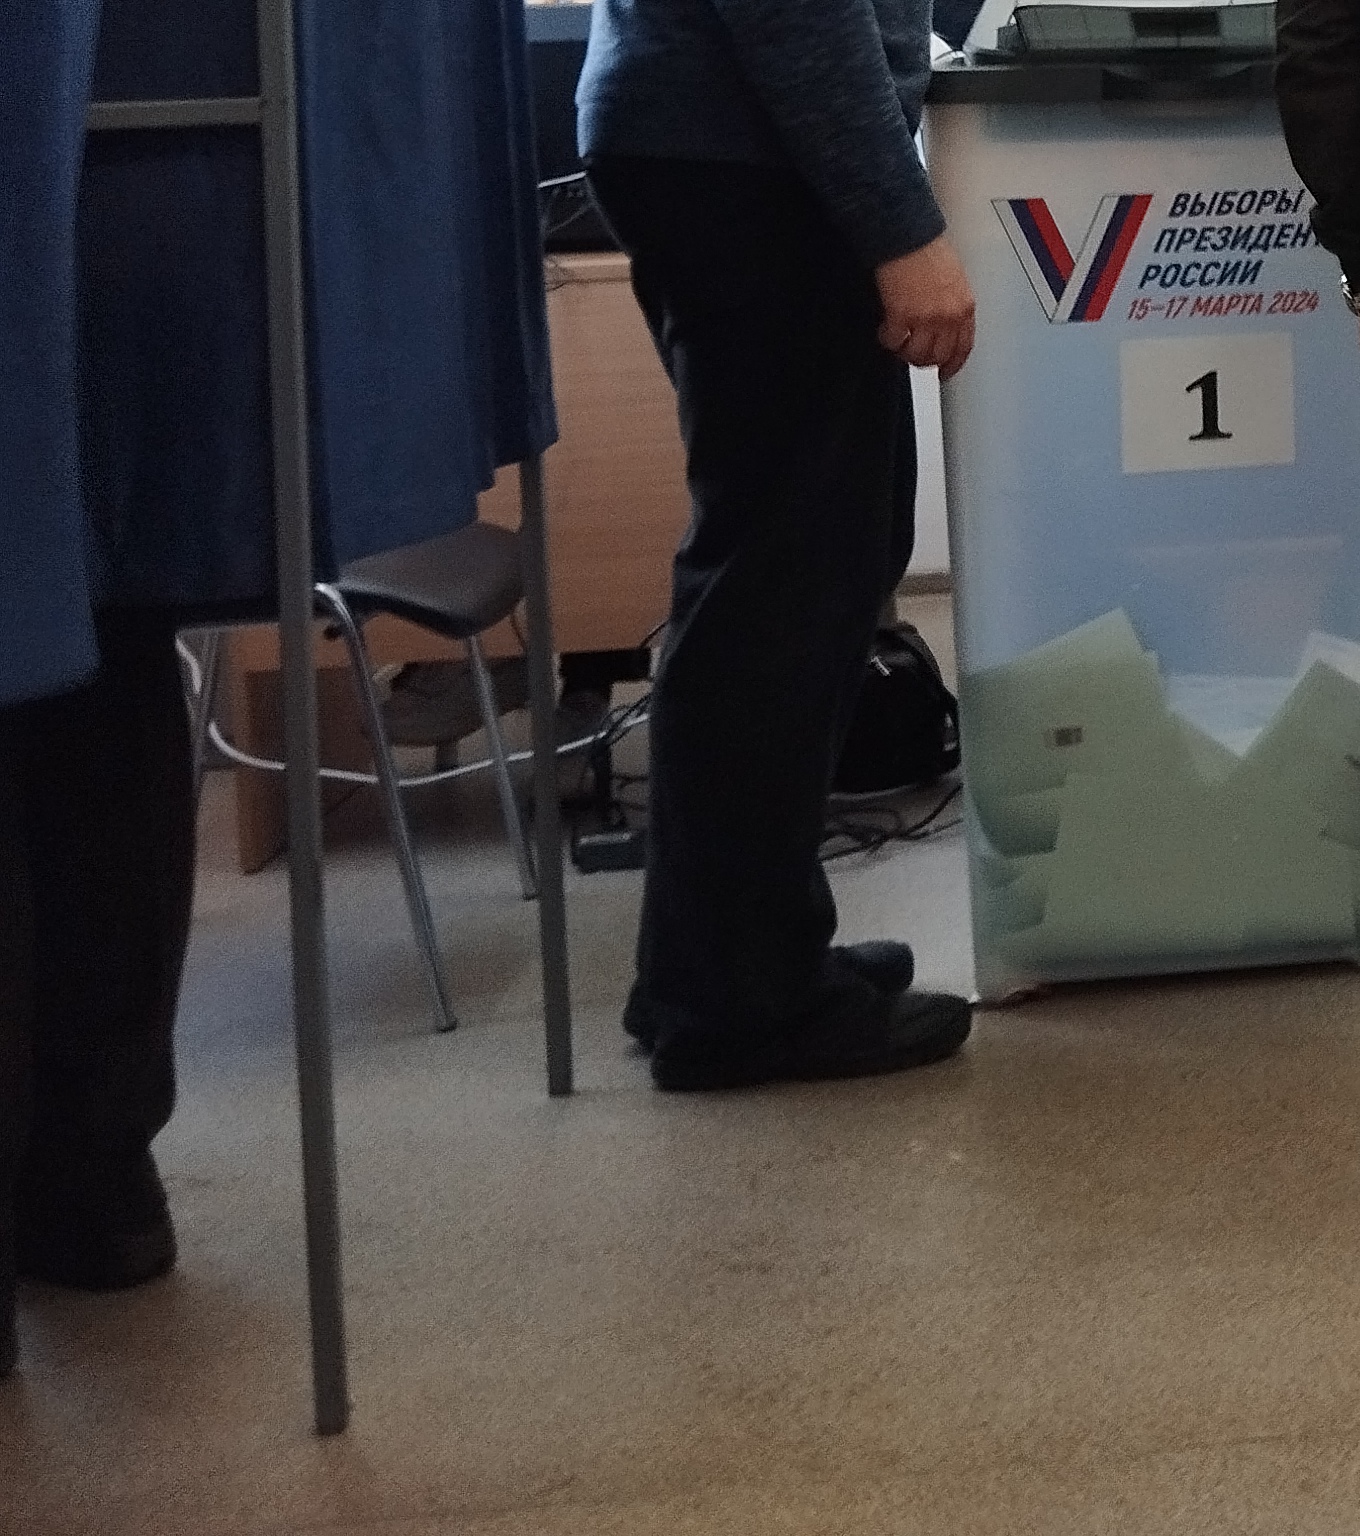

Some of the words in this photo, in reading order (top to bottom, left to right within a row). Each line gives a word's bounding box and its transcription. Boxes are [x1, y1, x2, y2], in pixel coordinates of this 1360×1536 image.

[1168, 188, 1306, 218] ВЫБОРЫ
[1153, 223, 1319, 254] ПРЕЗИДЕН
[1138, 260, 1264, 290] РОССИИ
[1188, 292, 1264, 317] МАРТА
[1266, 289, 1321, 315] 2024
[1185, 369, 1233, 441] 1
